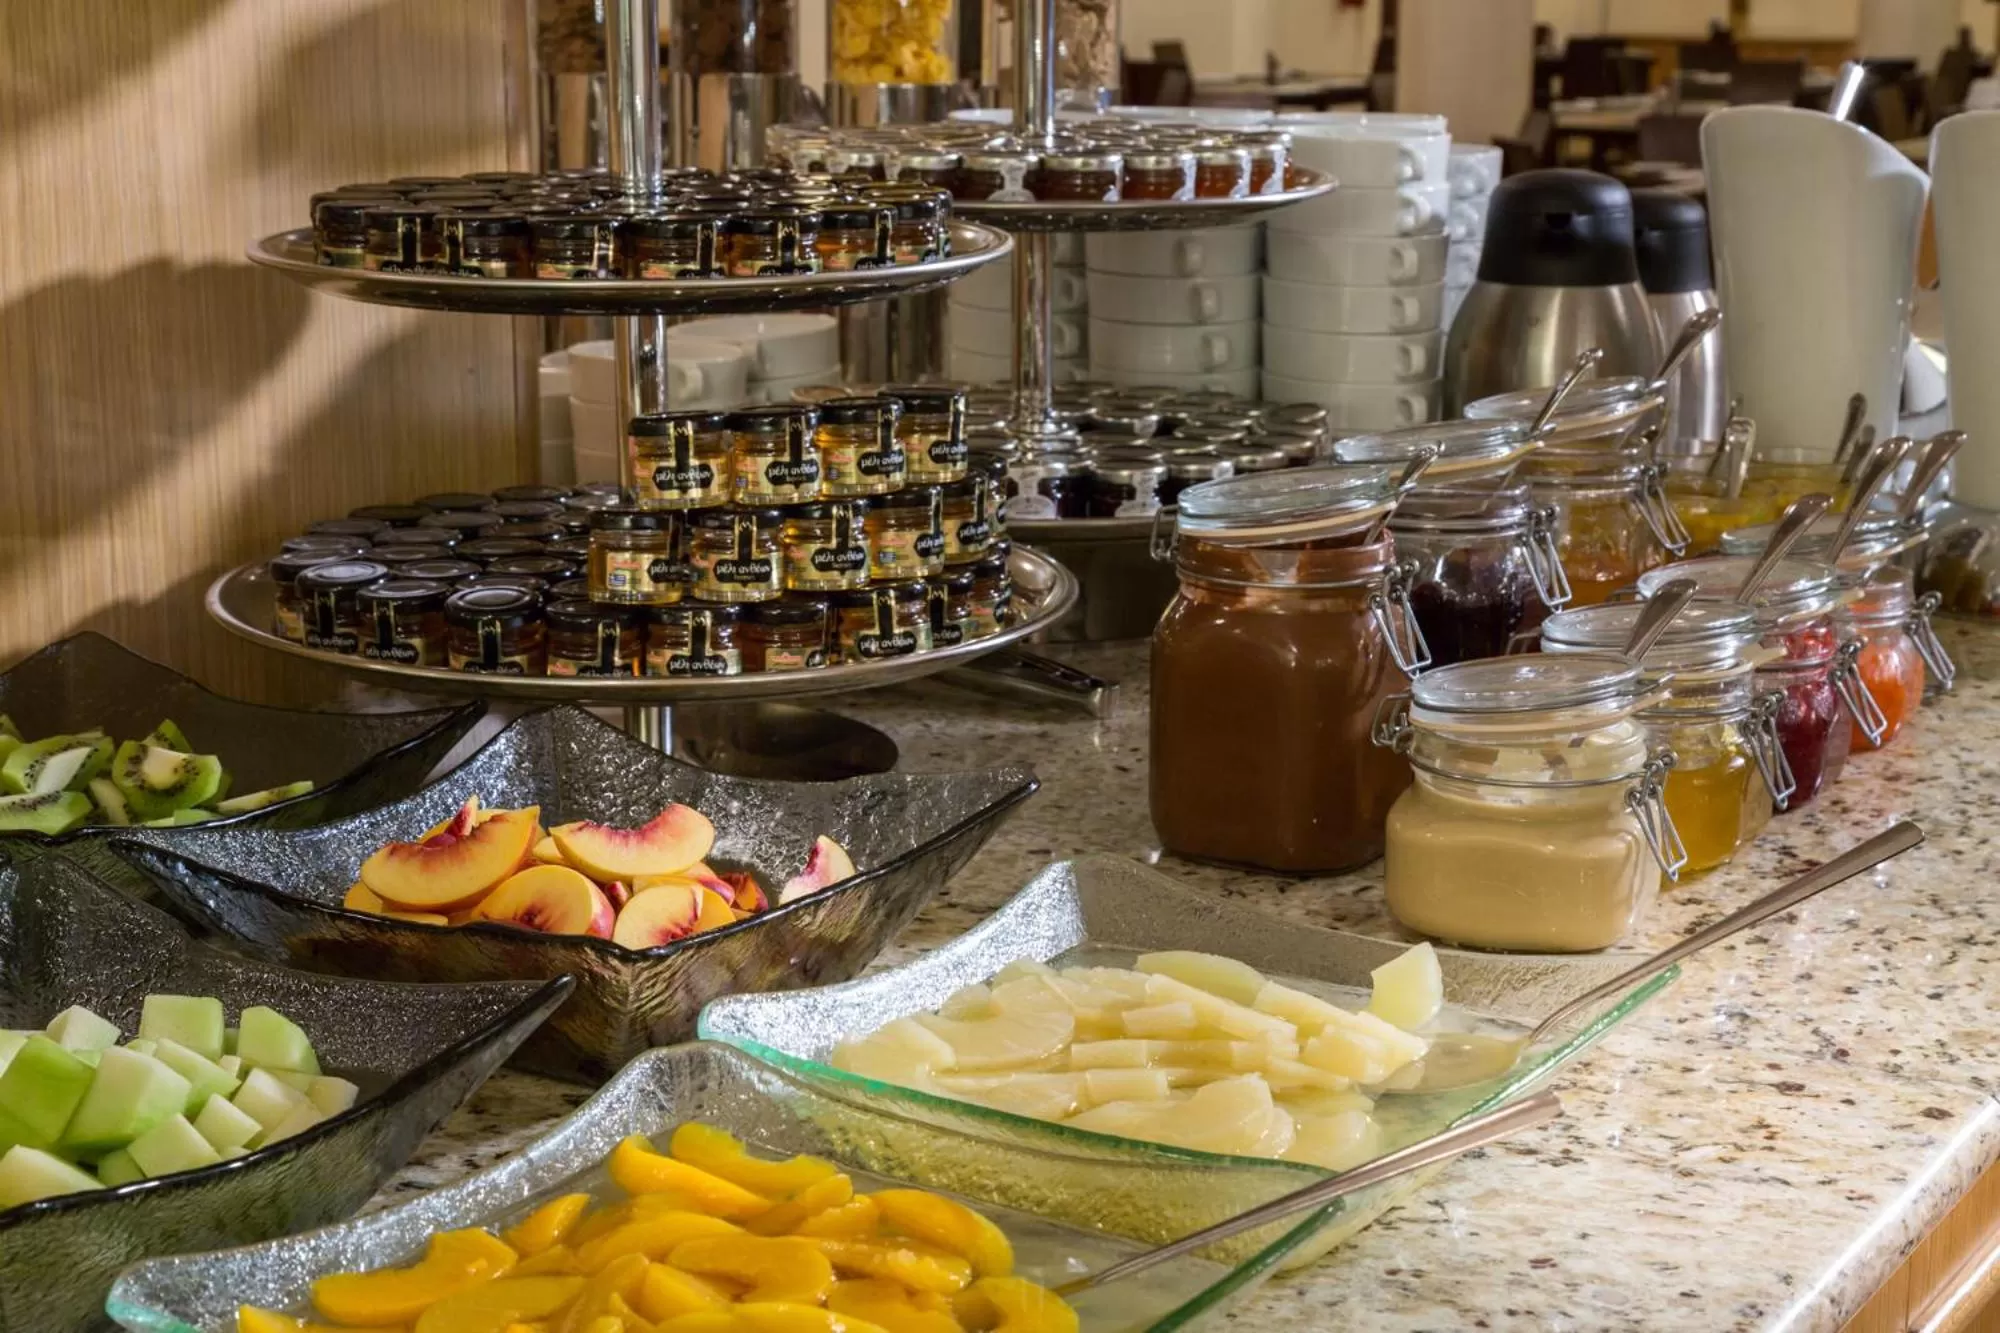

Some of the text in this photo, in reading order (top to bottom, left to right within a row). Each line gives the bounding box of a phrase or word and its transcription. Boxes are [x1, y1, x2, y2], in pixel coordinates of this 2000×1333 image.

[655, 470, 675, 482] μέλι
[768, 466, 788, 478] μέλι
[815, 551, 835, 564] μέλι
[716, 563, 736, 575] μέλι
[670, 659, 689, 671] μέλι
